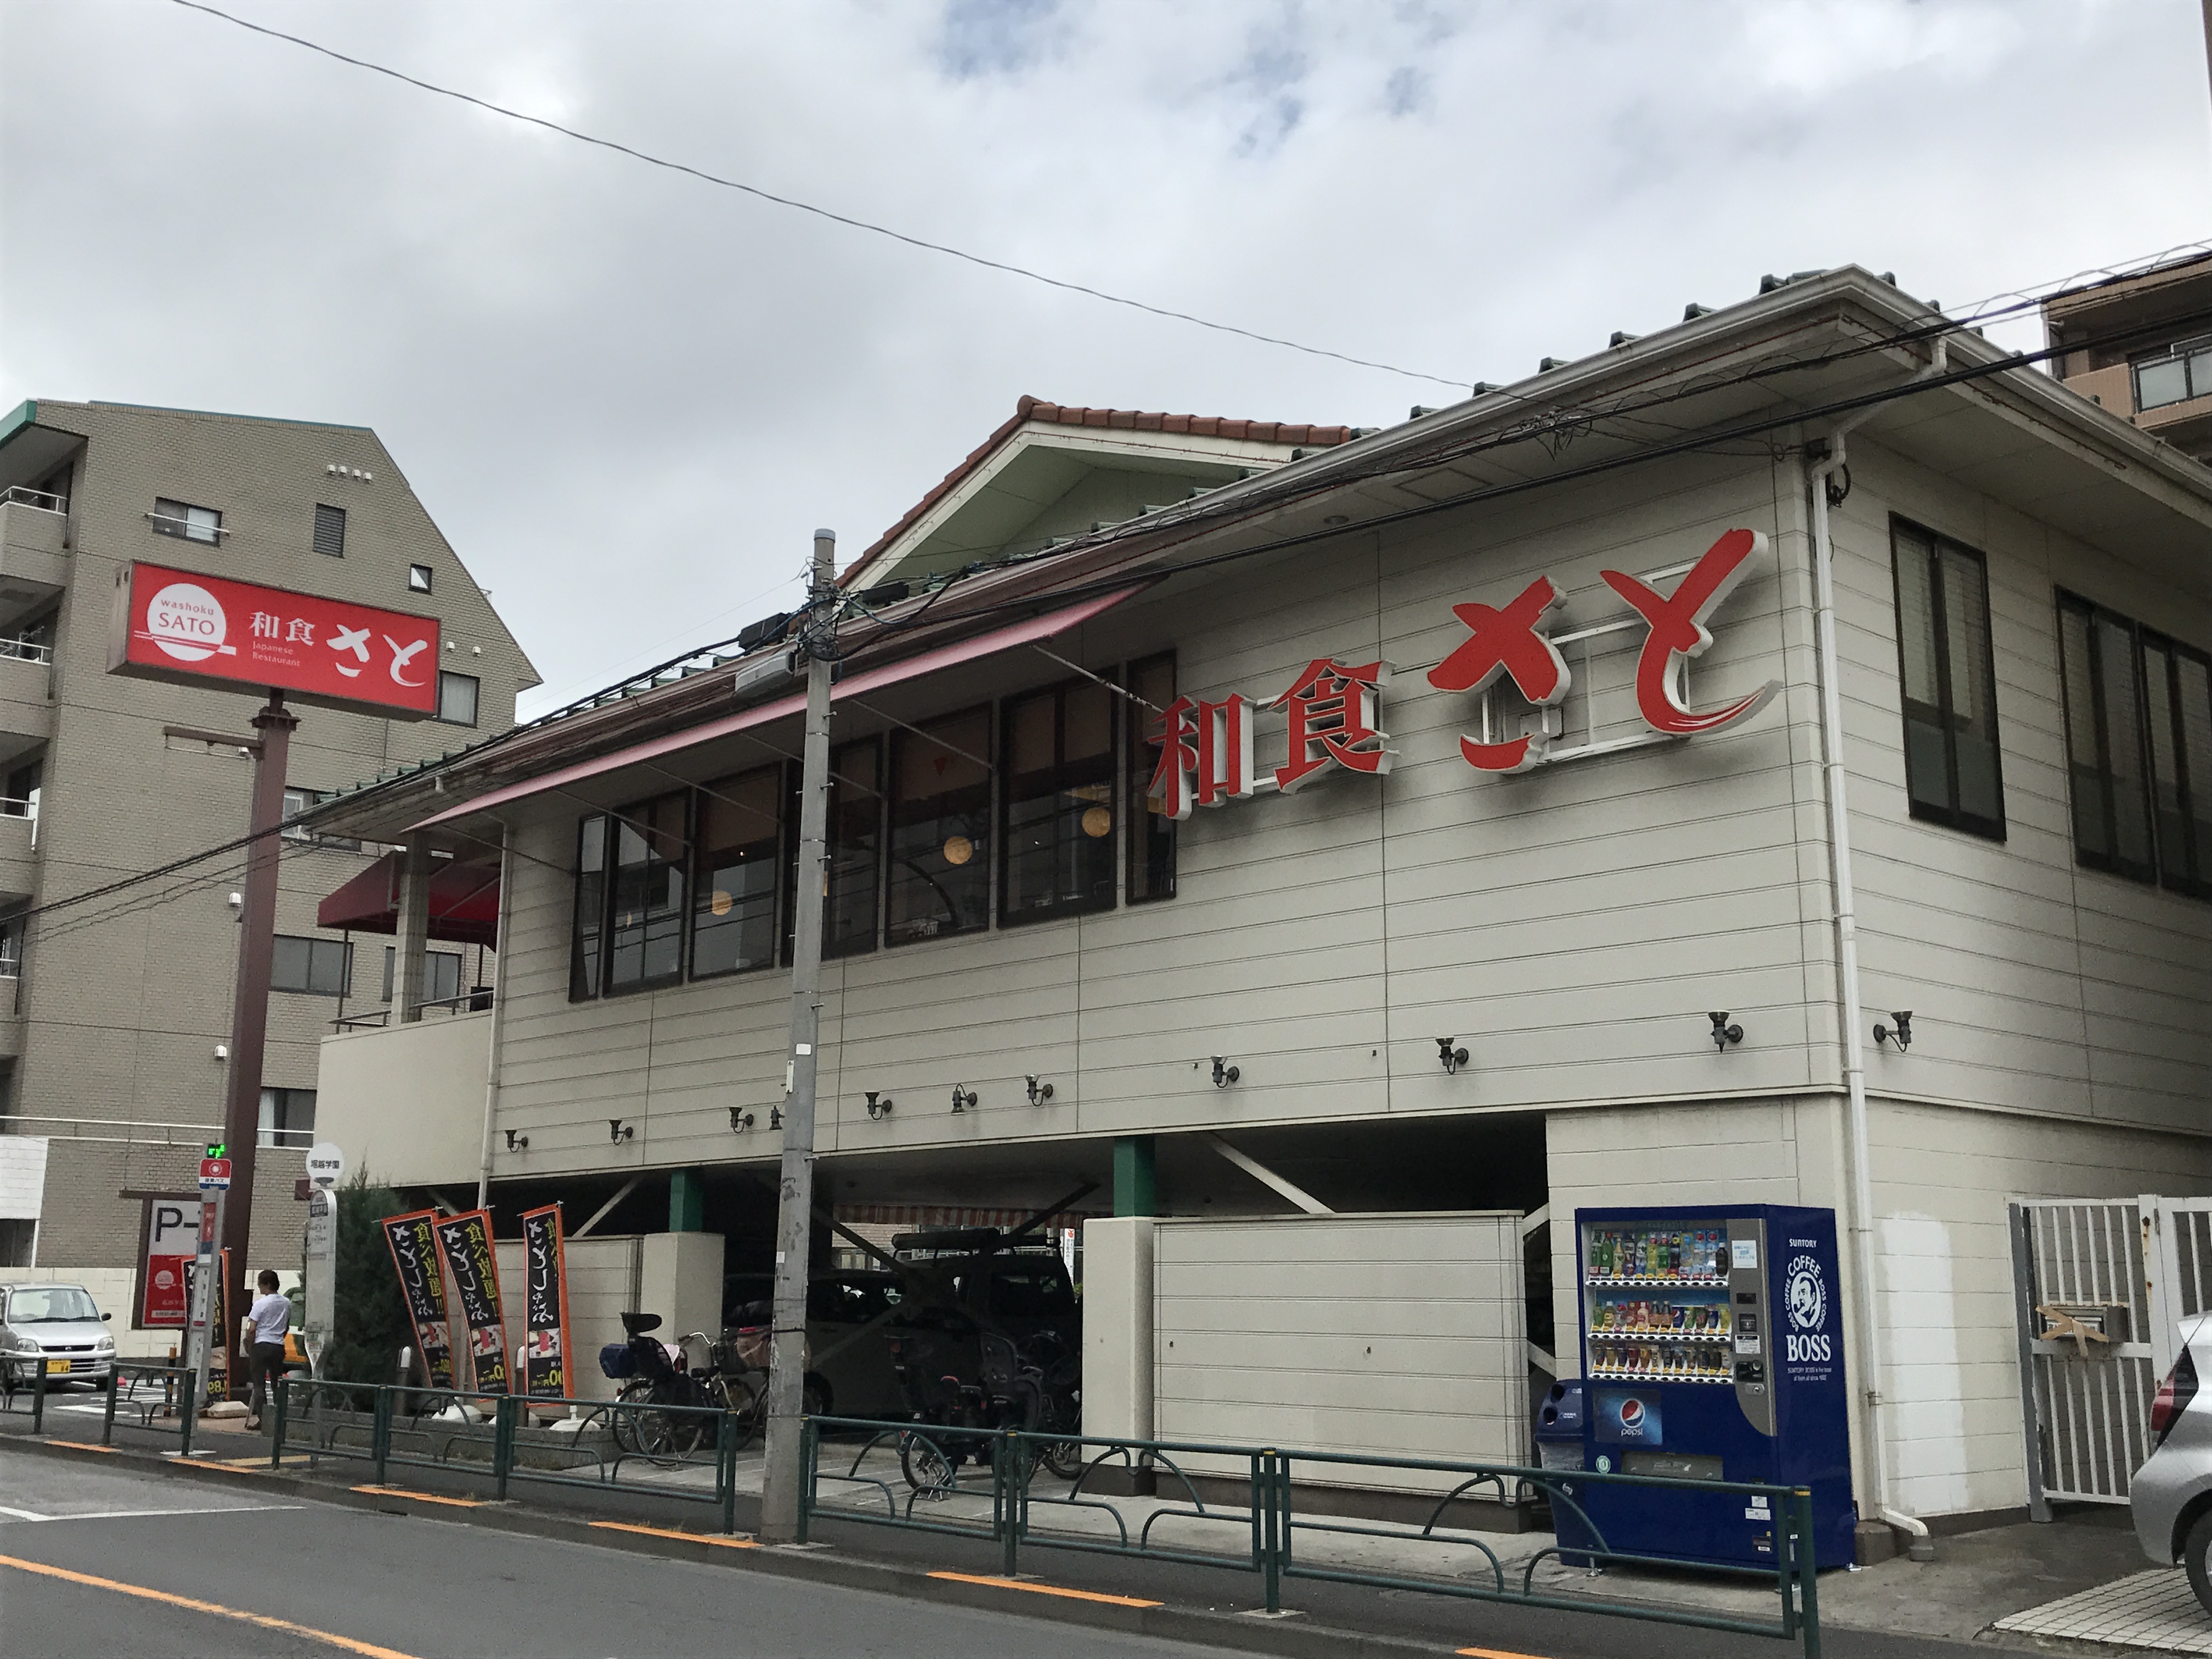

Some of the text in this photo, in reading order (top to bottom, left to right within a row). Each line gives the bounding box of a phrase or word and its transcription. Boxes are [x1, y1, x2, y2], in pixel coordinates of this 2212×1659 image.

[161, 599, 214, 616] washoku
[158, 612, 215, 635] SATO
[249, 611, 428, 687] 和食 さと
[253, 641, 294, 654] Japanese
[252, 652, 301, 667] Restaurant
[1147, 528, 1776, 819] 和食 さと
[155, 1207, 183, 1242] P
[1789, 1238, 1817, 1248] SUNTORY
[1788, 1255, 1821, 1278] COFFEE
[1786, 1334, 1831, 1362] BOSS
[1621, 1428, 1643, 1437] pepsi
